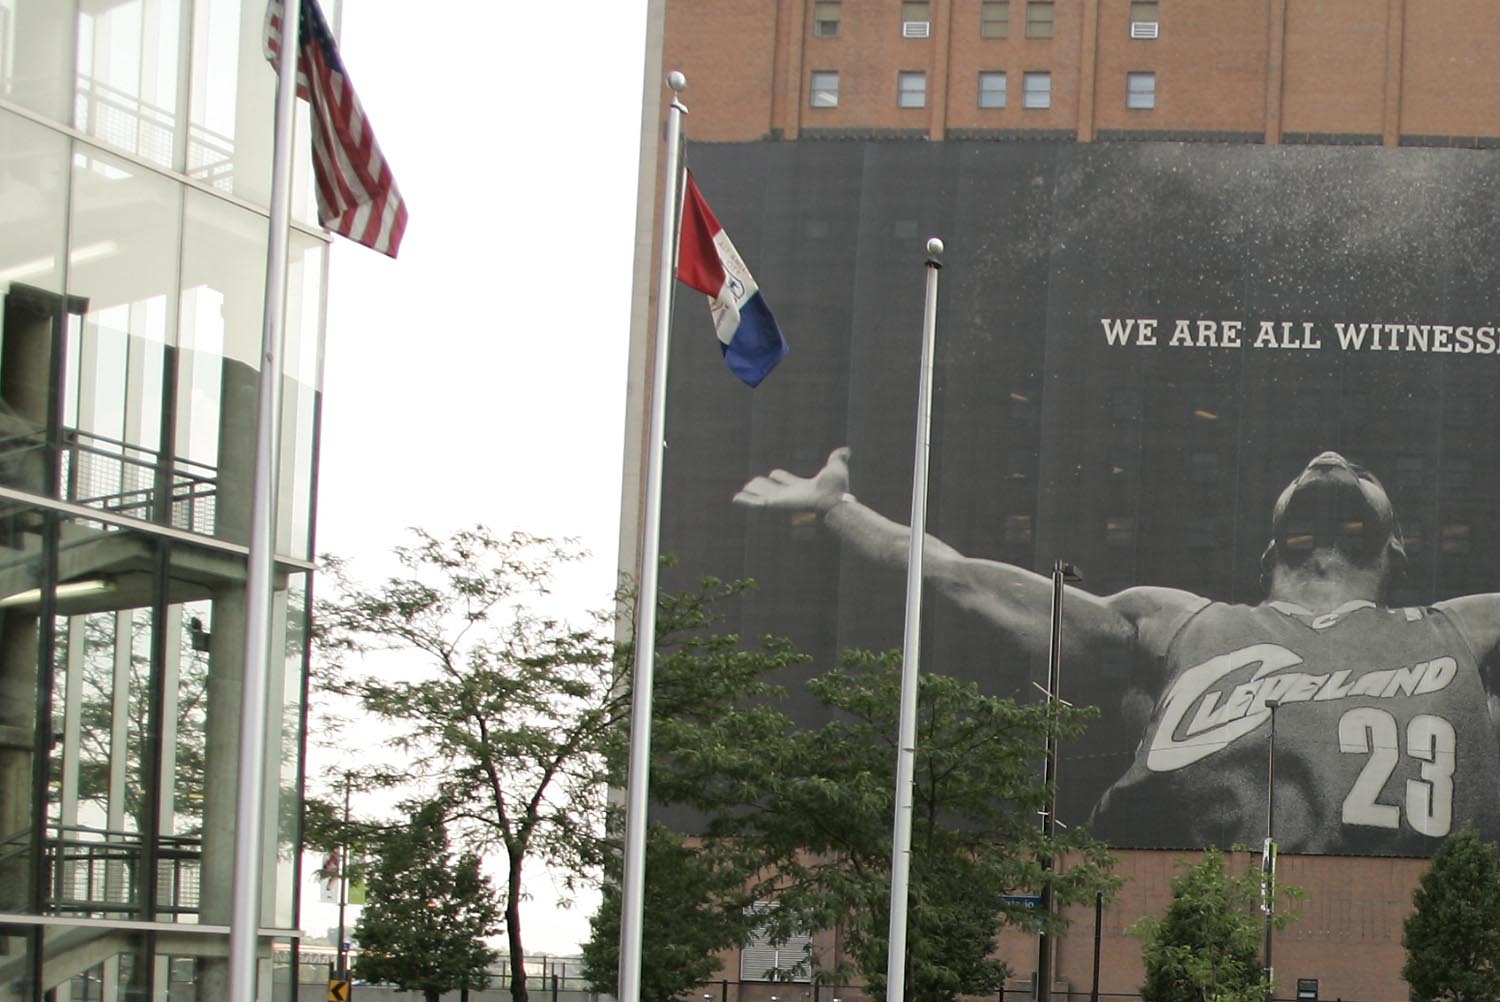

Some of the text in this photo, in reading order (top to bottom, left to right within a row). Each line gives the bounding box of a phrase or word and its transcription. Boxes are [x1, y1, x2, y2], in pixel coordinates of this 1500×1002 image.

[1101, 318, 1157, 346] WE
[1169, 320, 1241, 347] ARE
[1254, 322, 1321, 348] ALL
[1339, 706, 1457, 837] 23
